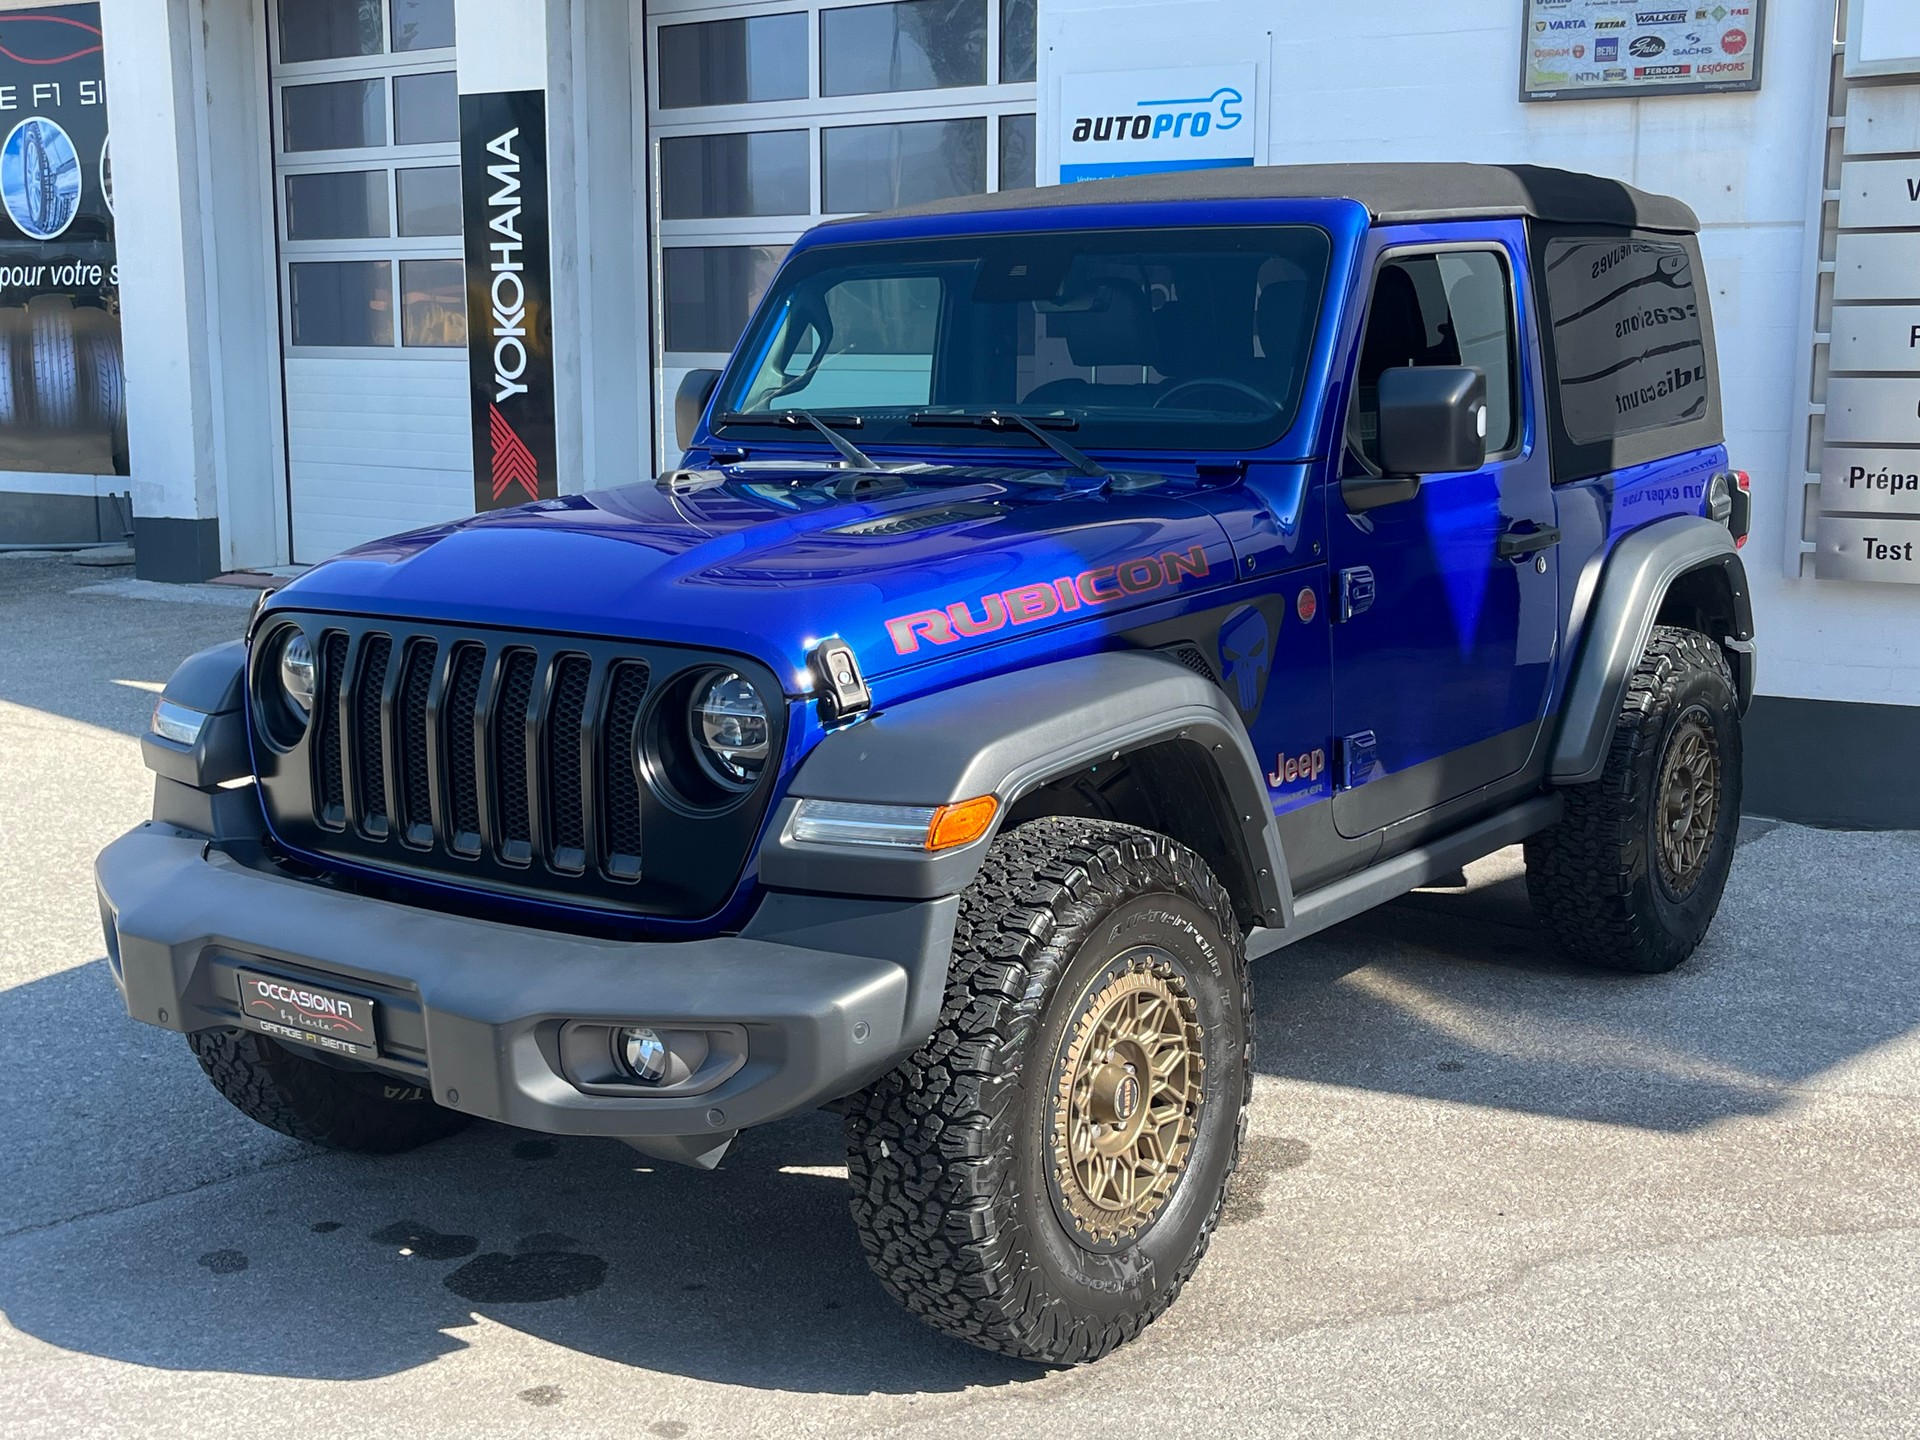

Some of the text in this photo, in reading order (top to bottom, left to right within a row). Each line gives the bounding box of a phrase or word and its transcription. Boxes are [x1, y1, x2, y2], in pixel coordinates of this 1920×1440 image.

[1636, 12, 1687, 23] WALKER
[1730, 8, 1749, 16] FAG
[1549, 20, 1586, 30] VARTA
[1594, 21, 1626, 30] TEXTAR
[1596, 46, 1617, 56] BERU
[1630, 38, 1663, 56] Gates
[1672, 47, 1713, 56] SACHS
[1575, 72, 1600, 81] NTN
[1645, 66, 1680, 75] FERODO
[33, 82, 60, 108] F1
[486, 127, 528, 403] YOKOHAMA
[0, 265, 46, 293] pour
[51, 259, 102, 286] votre
[1850, 464, 1918, 495] Prépa
[1863, 537, 1913, 561] Test
[884, 544, 1210, 655] RUBICON
[1268, 748, 1325, 788] Jeep
[257, 981, 353, 1018] OCCASION F1
[260, 1021, 302, 1040] GARAGE
[321, 1037, 357, 1054] SIERRE
